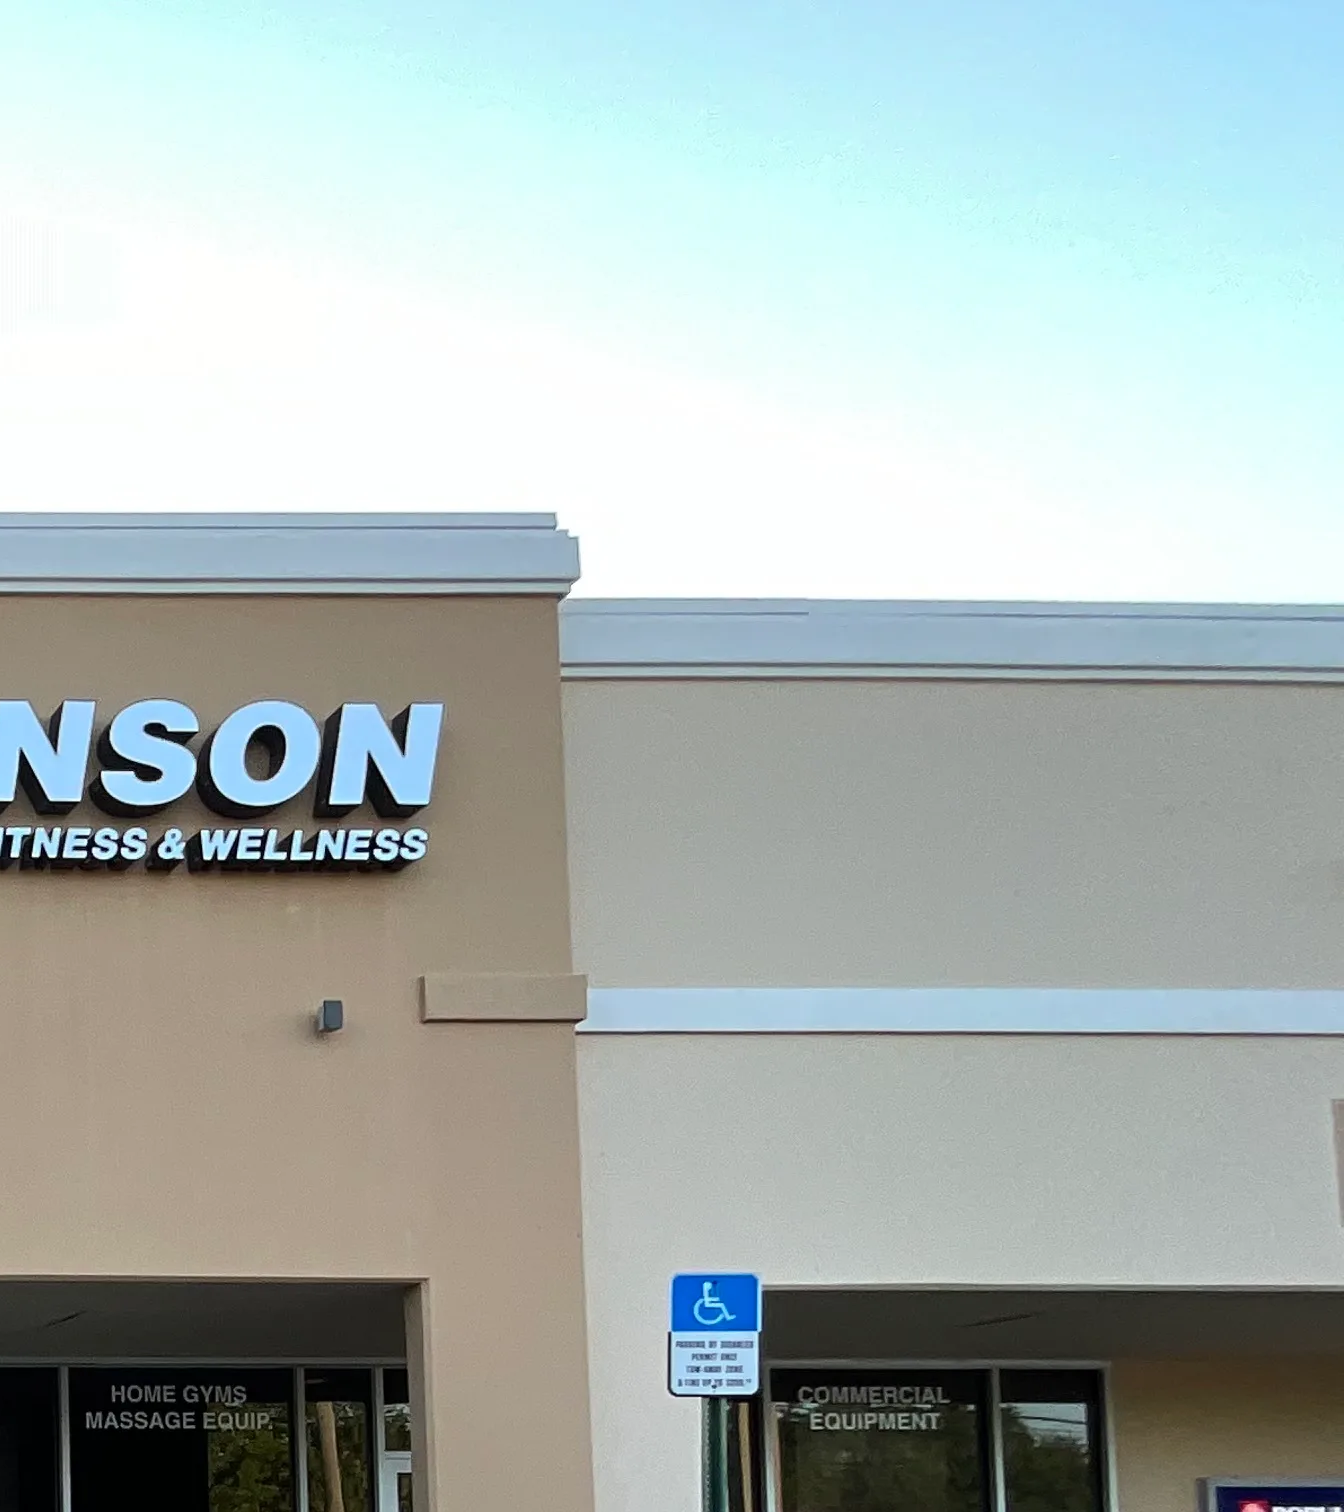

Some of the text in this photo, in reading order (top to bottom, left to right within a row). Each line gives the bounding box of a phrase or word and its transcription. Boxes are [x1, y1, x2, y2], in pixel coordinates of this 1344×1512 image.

[157, 827, 188, 863] &
[200, 828, 430, 864] WELLNESS
[111, 1385, 248, 1404] HOME GYMS
[798, 1386, 951, 1404] COMMERCIAL
[85, 1411, 273, 1431] MASSAGE EQUIP.
[809, 1412, 940, 1430] EQUIPMENT
